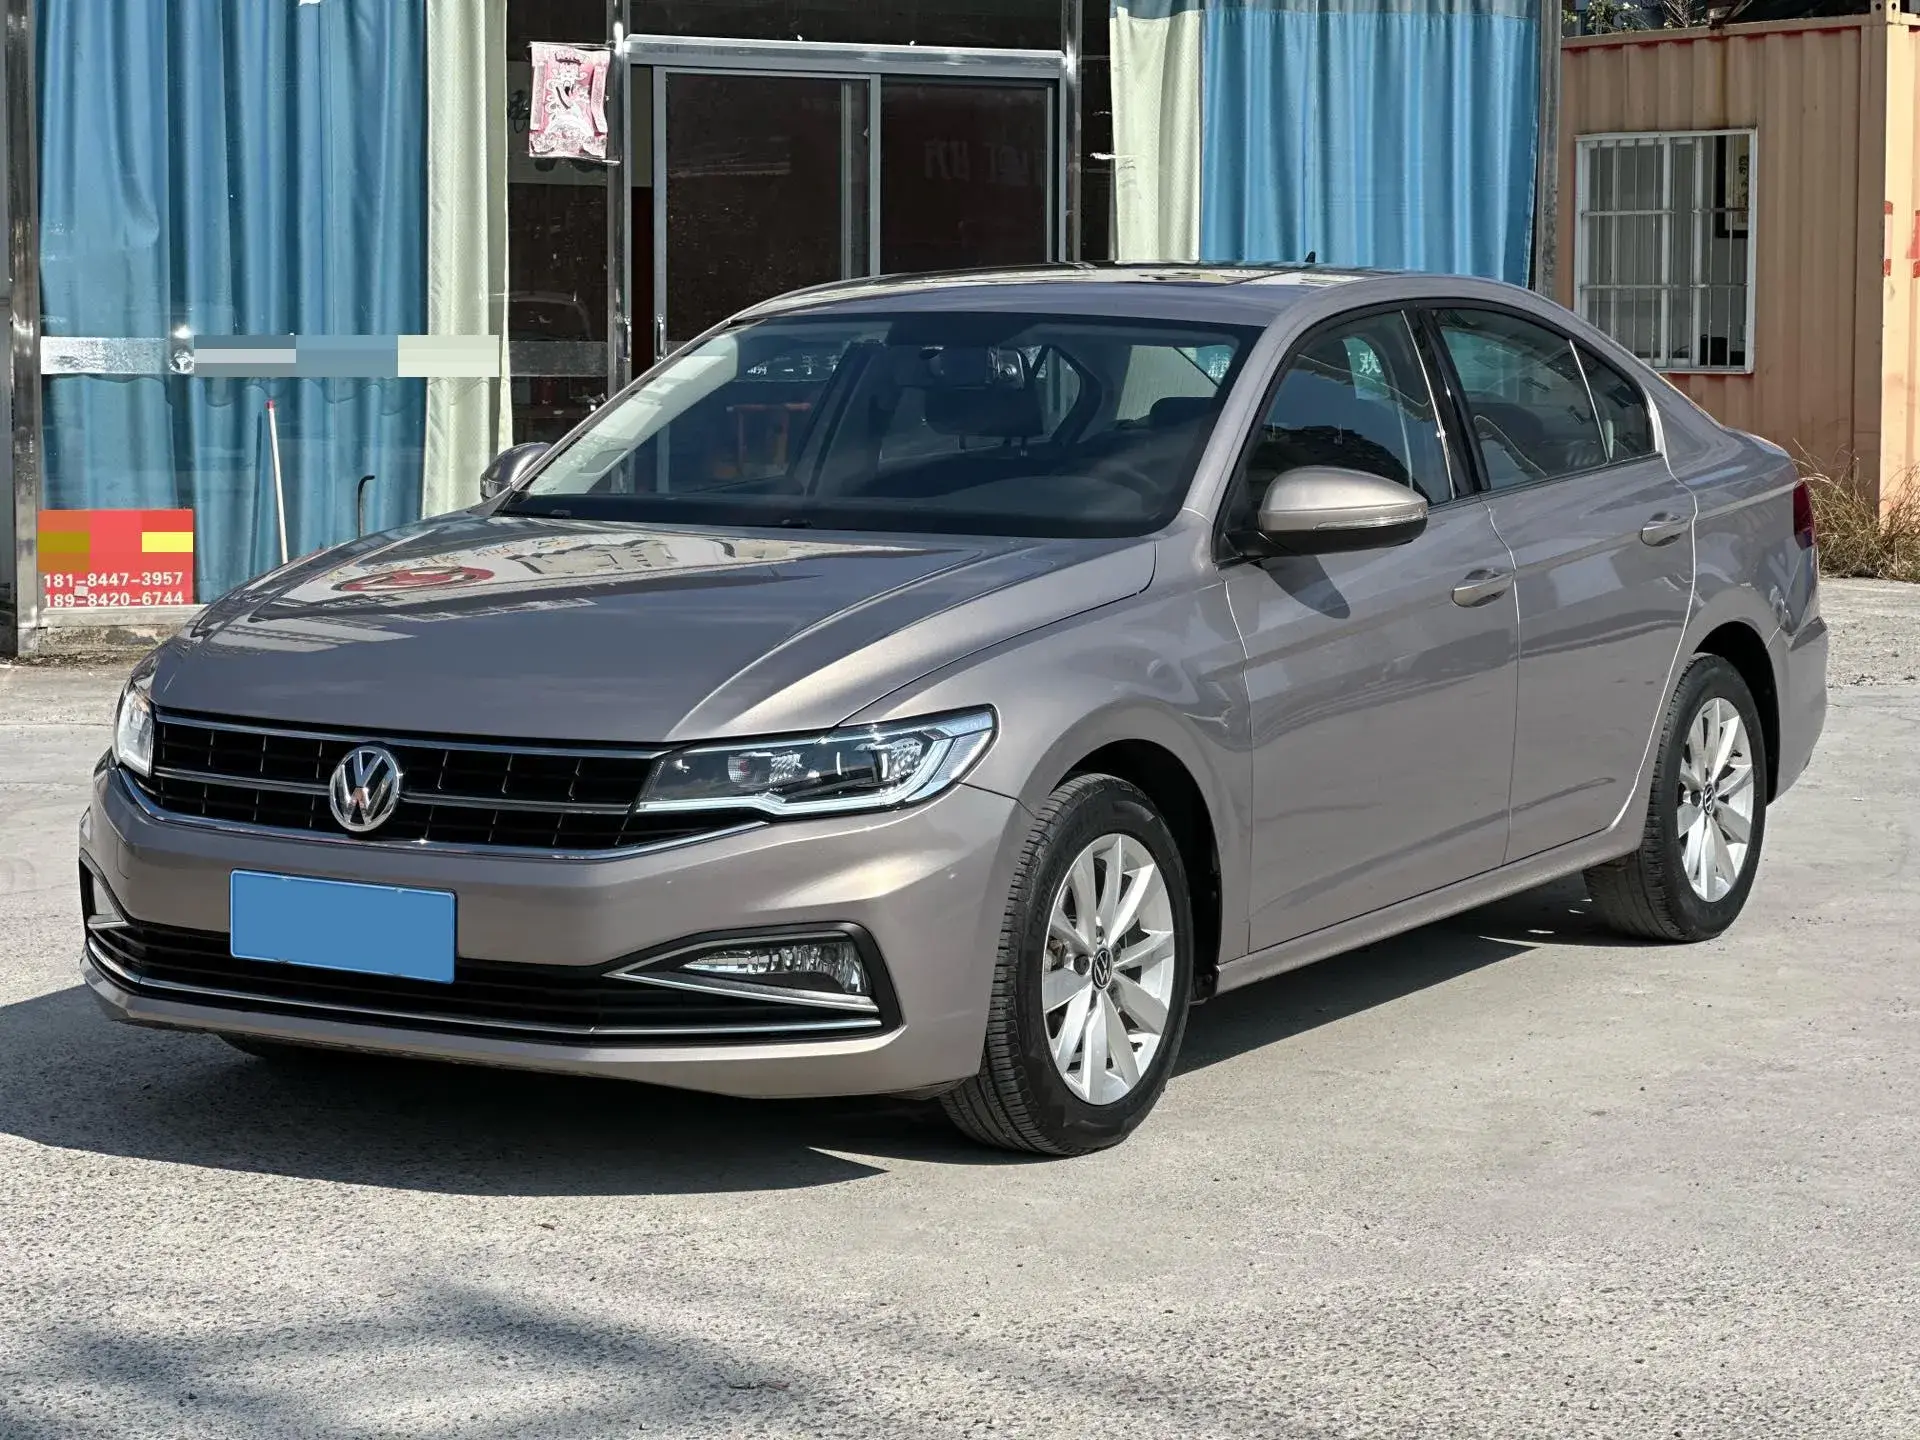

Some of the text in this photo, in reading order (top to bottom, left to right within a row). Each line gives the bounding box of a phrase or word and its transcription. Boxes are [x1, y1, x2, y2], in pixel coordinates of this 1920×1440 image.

[44, 572, 183, 588] 181-8447-3957
[44, 592, 184, 607] 189-8420-6744
[330, 746, 399, 831] VW
